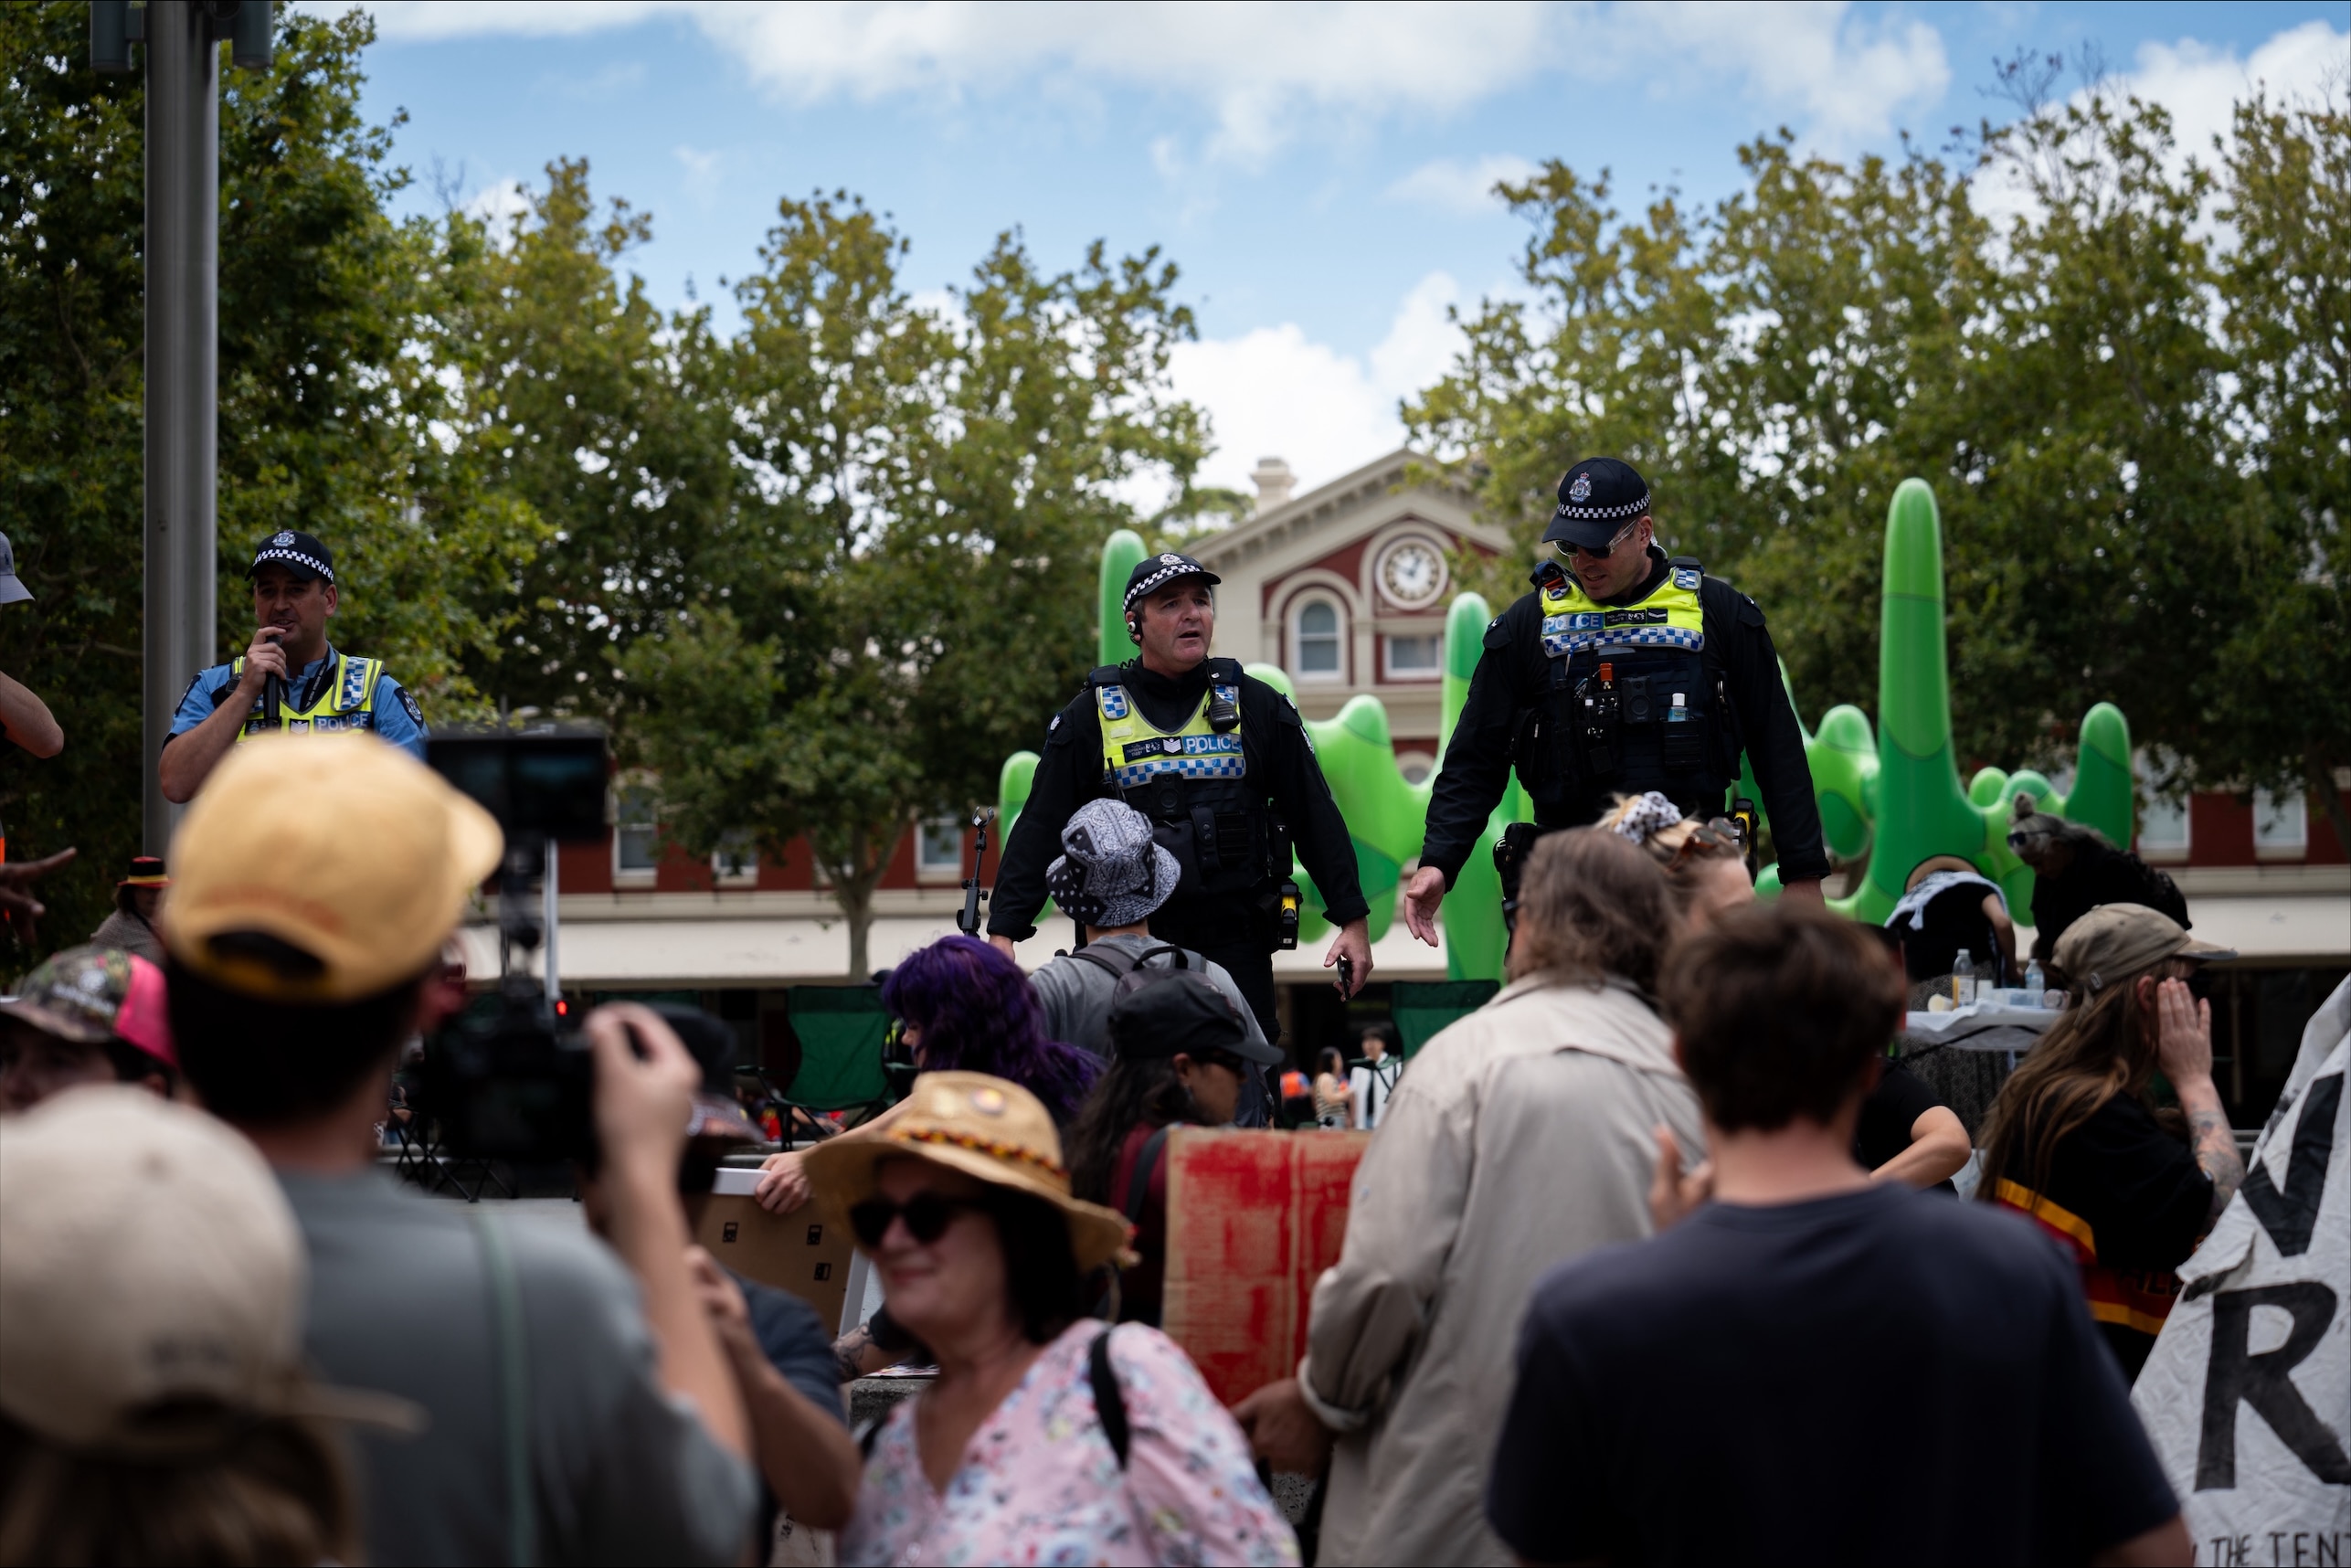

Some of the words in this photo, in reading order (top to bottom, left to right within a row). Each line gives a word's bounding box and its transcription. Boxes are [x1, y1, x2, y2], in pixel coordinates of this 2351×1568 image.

[317, 713, 368, 731] POLICE
[2210, 1534, 2251, 1567] THE
[2268, 1531, 2351, 1567] TEN
